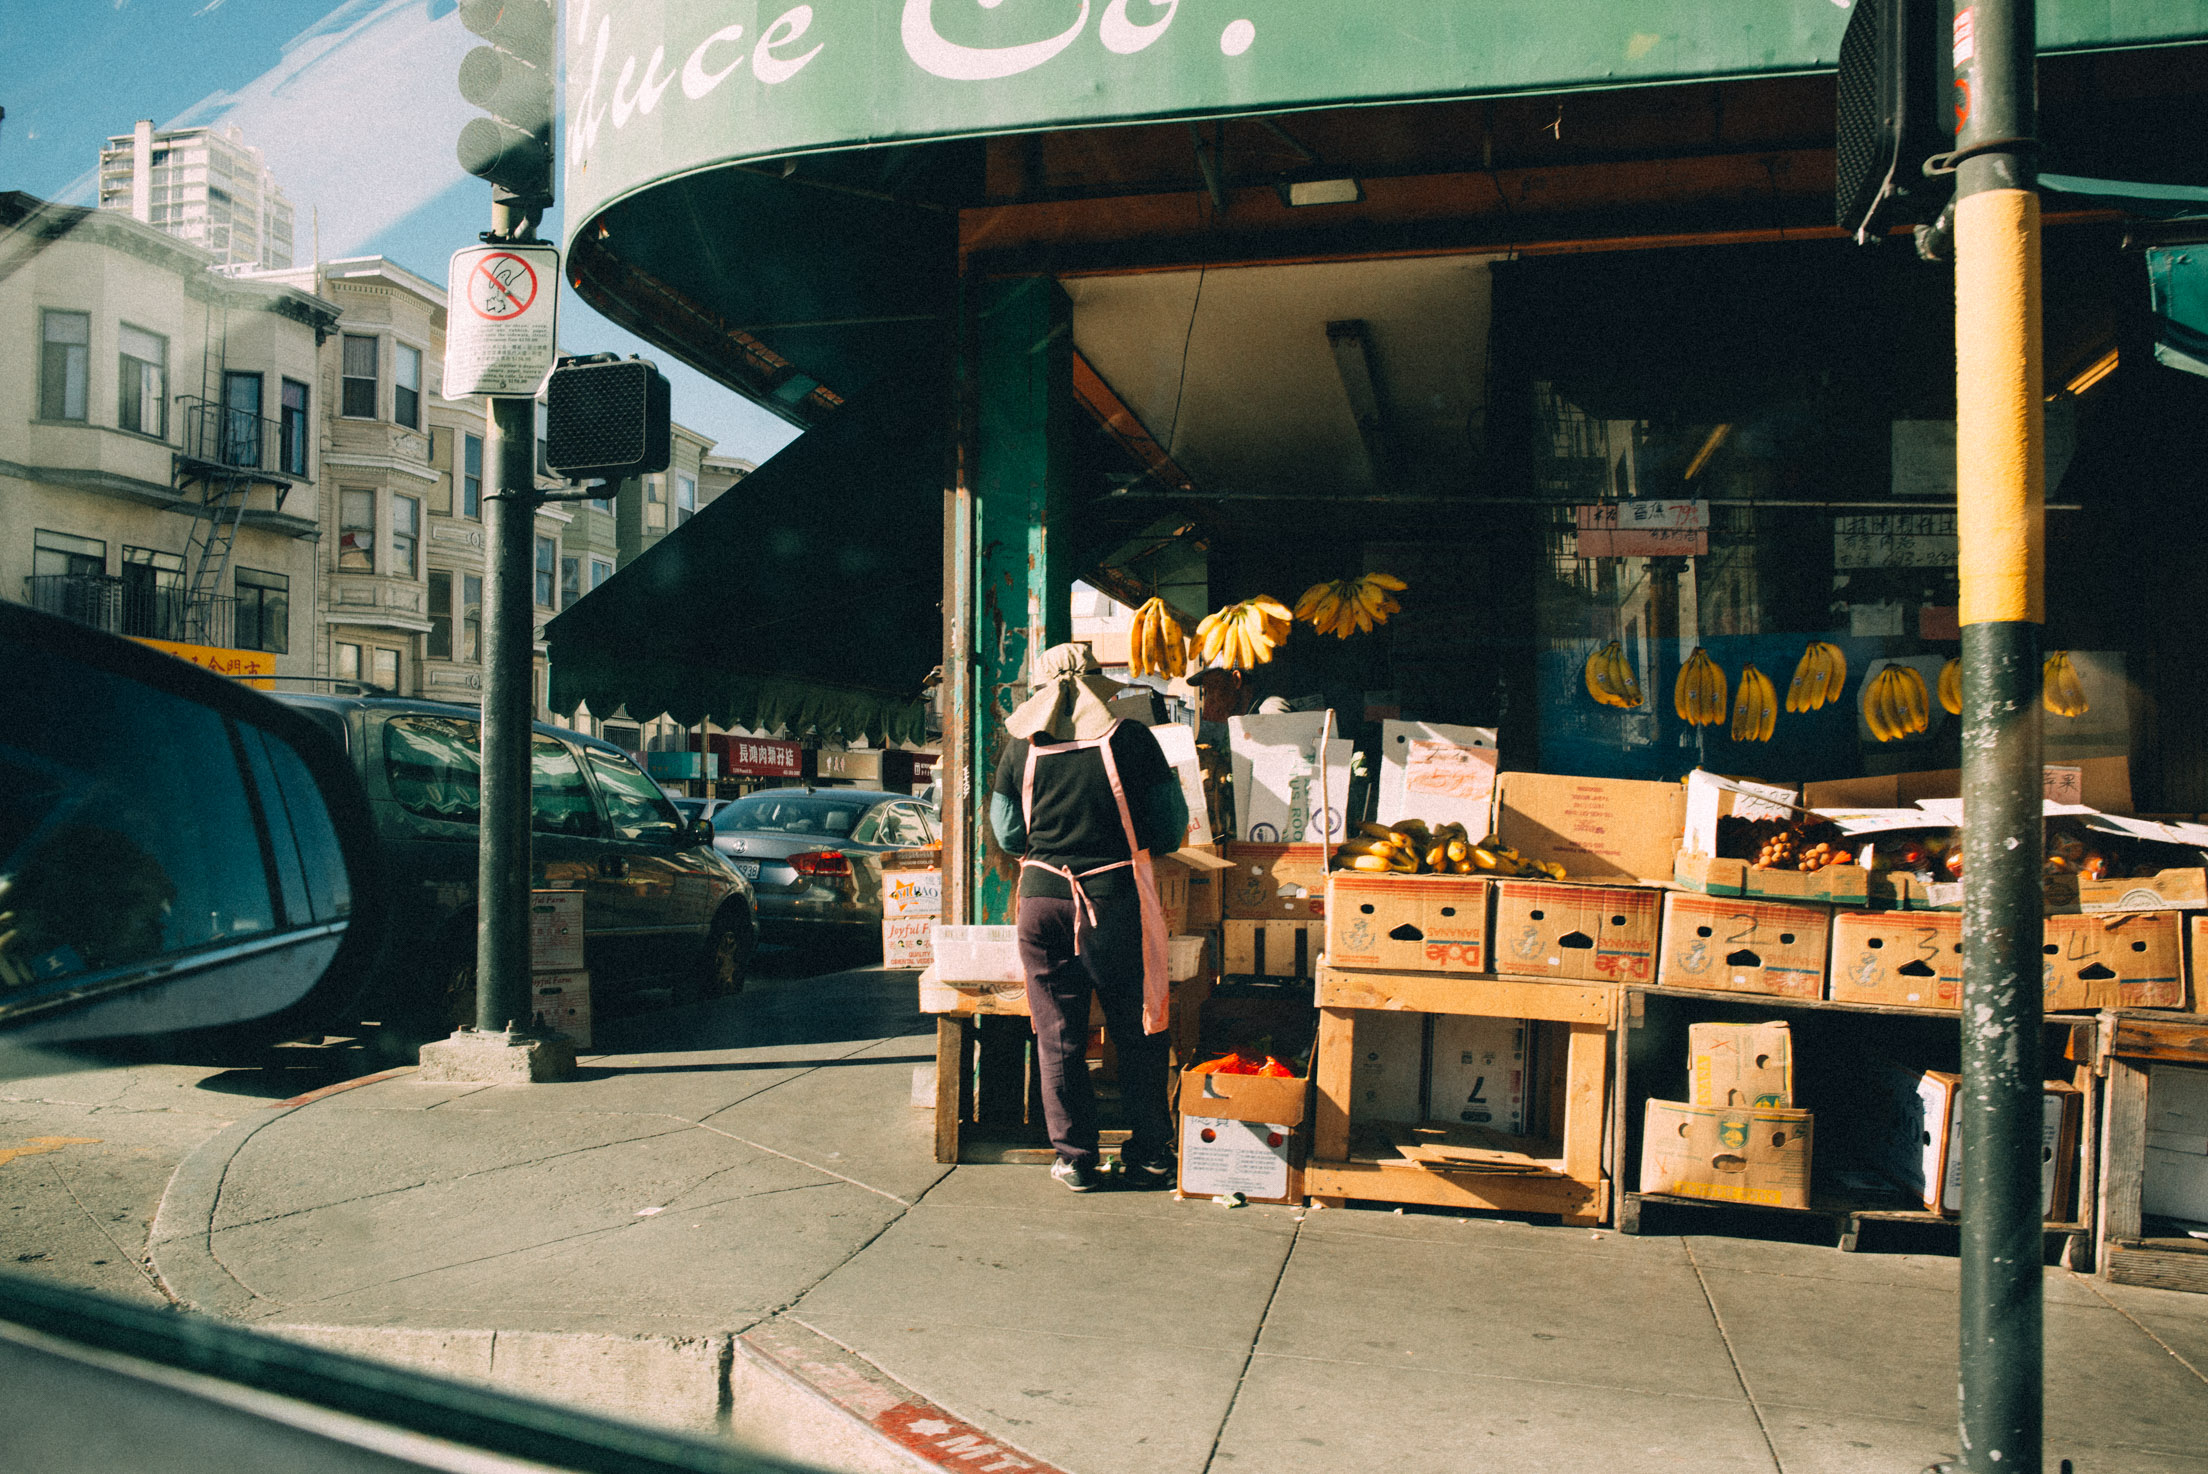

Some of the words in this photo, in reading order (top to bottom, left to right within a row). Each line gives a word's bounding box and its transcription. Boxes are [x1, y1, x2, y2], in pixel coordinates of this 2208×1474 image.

[888, 922, 920, 938] Joyful
[1427, 927, 1480, 938] BANANAS
[1725, 913, 1772, 945] 2
[1425, 943, 1480, 967] Dole
[1595, 953, 1650, 979] Dole
